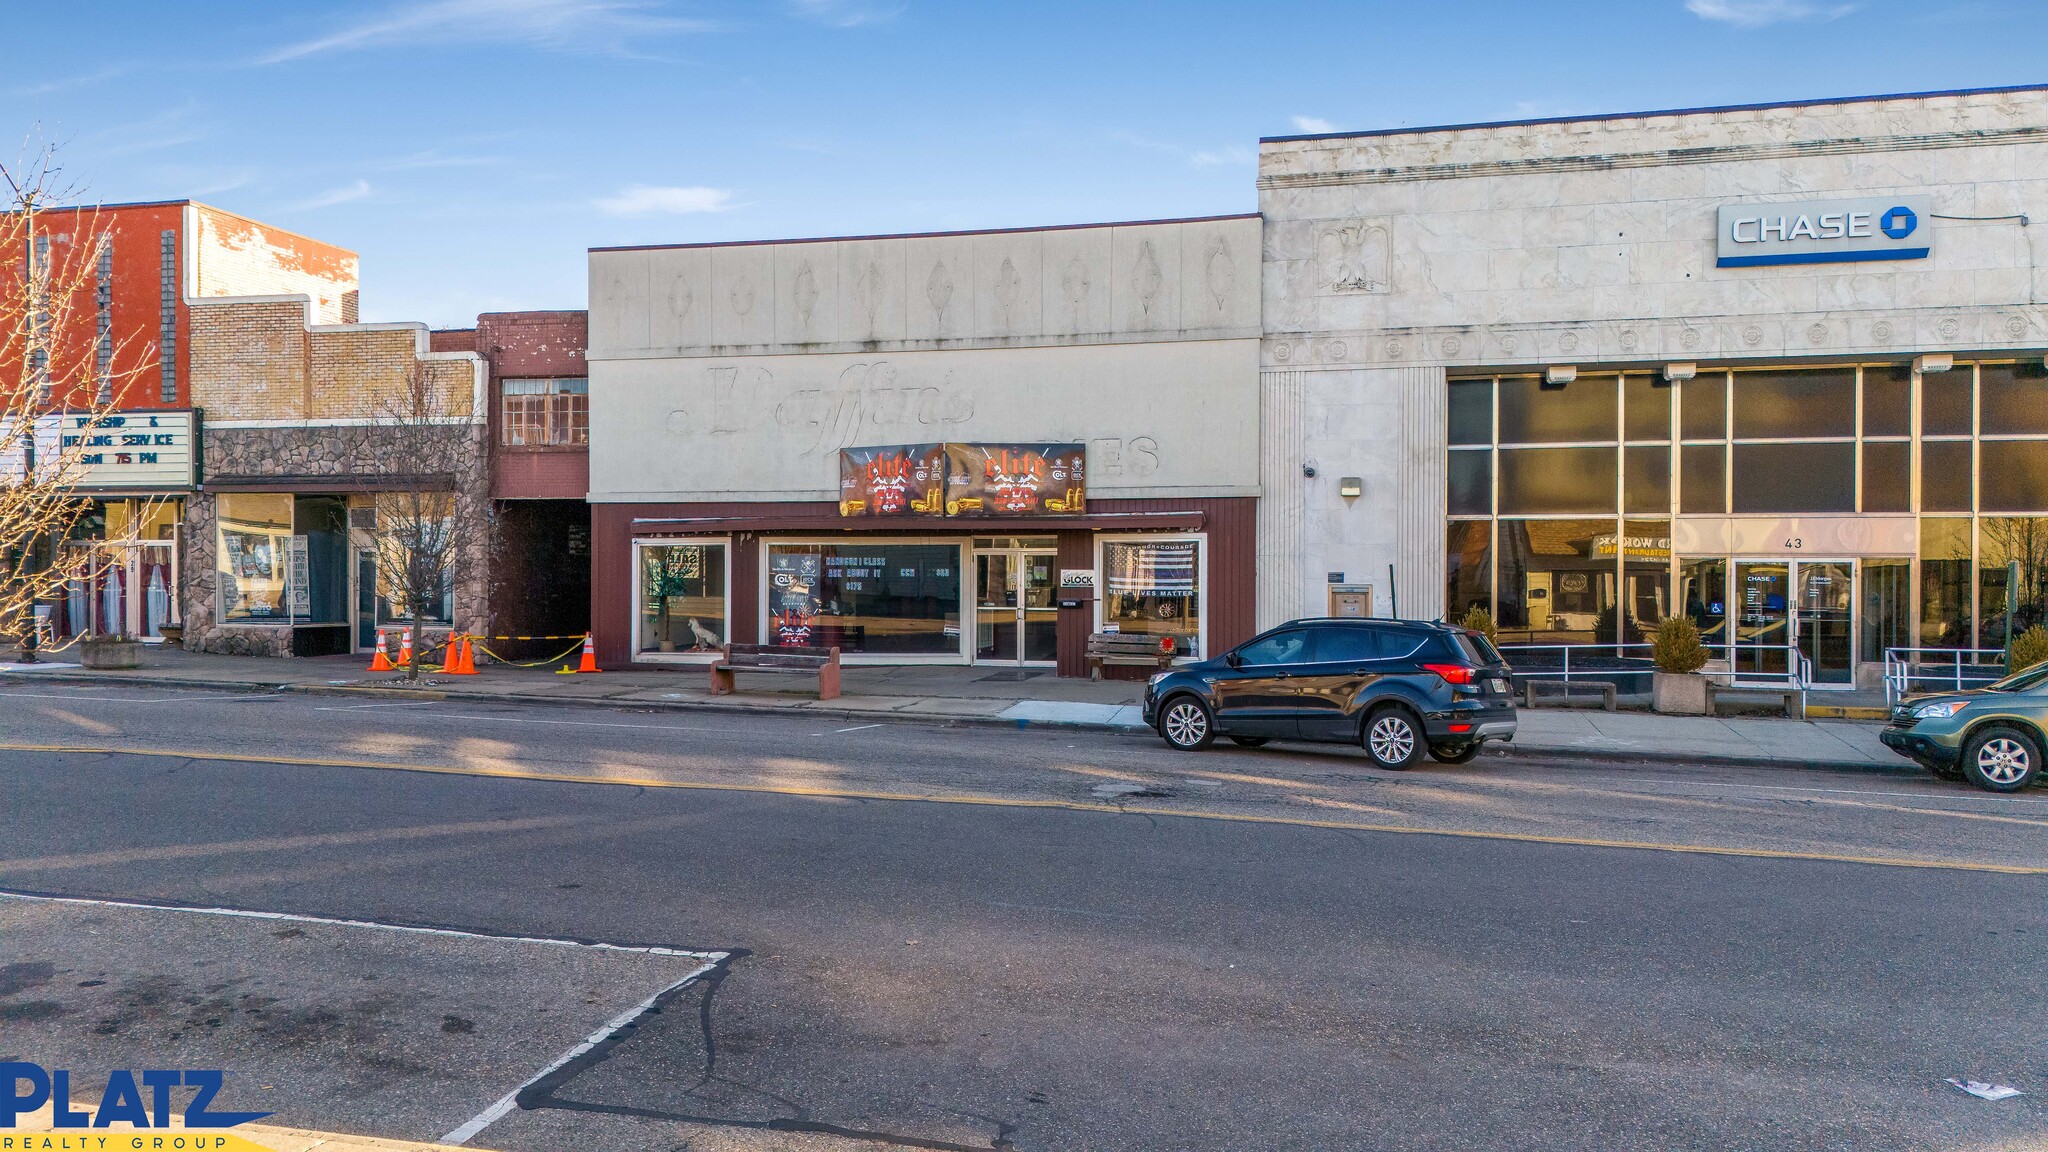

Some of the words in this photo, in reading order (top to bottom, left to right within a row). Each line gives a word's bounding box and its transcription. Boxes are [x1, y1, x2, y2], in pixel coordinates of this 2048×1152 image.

[1732, 211, 1873, 243] CHASE
[139, 452, 157, 463] PM
[984, 449, 1046, 477] elite
[1784, 538, 1802, 549] 43
